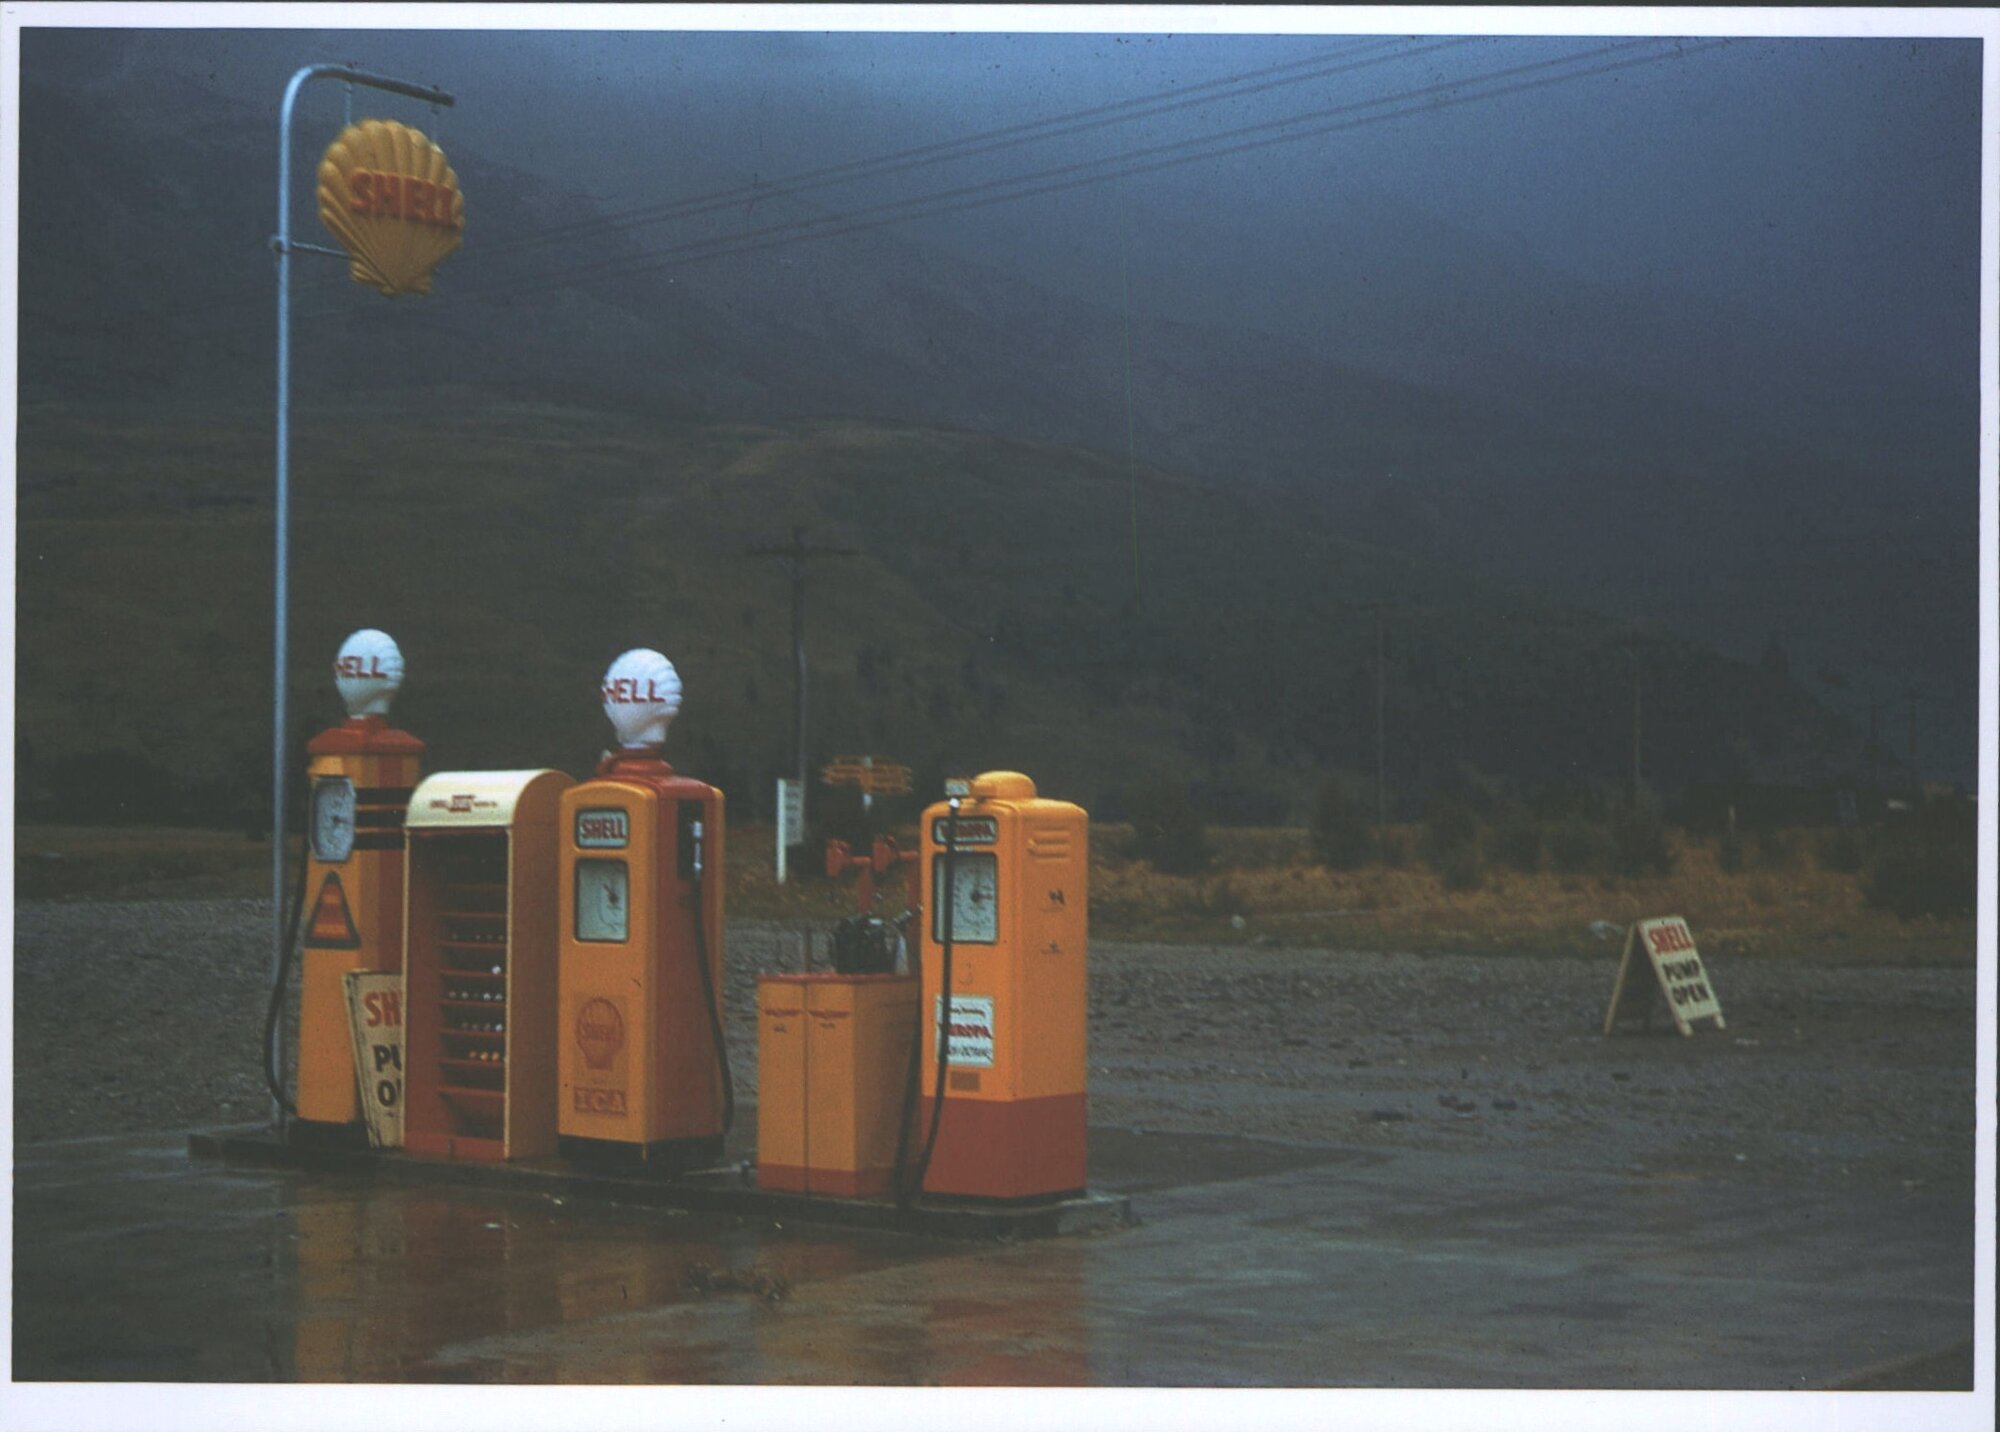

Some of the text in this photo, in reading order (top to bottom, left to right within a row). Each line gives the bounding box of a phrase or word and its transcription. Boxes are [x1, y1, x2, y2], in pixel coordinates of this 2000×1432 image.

[350, 169, 457, 227] SHELL
[582, 816, 628, 839] SHELL
[1649, 925, 1695, 955] SHELL
[1662, 959, 1701, 983] PUMP
[1671, 983, 1710, 1005] OPEN
